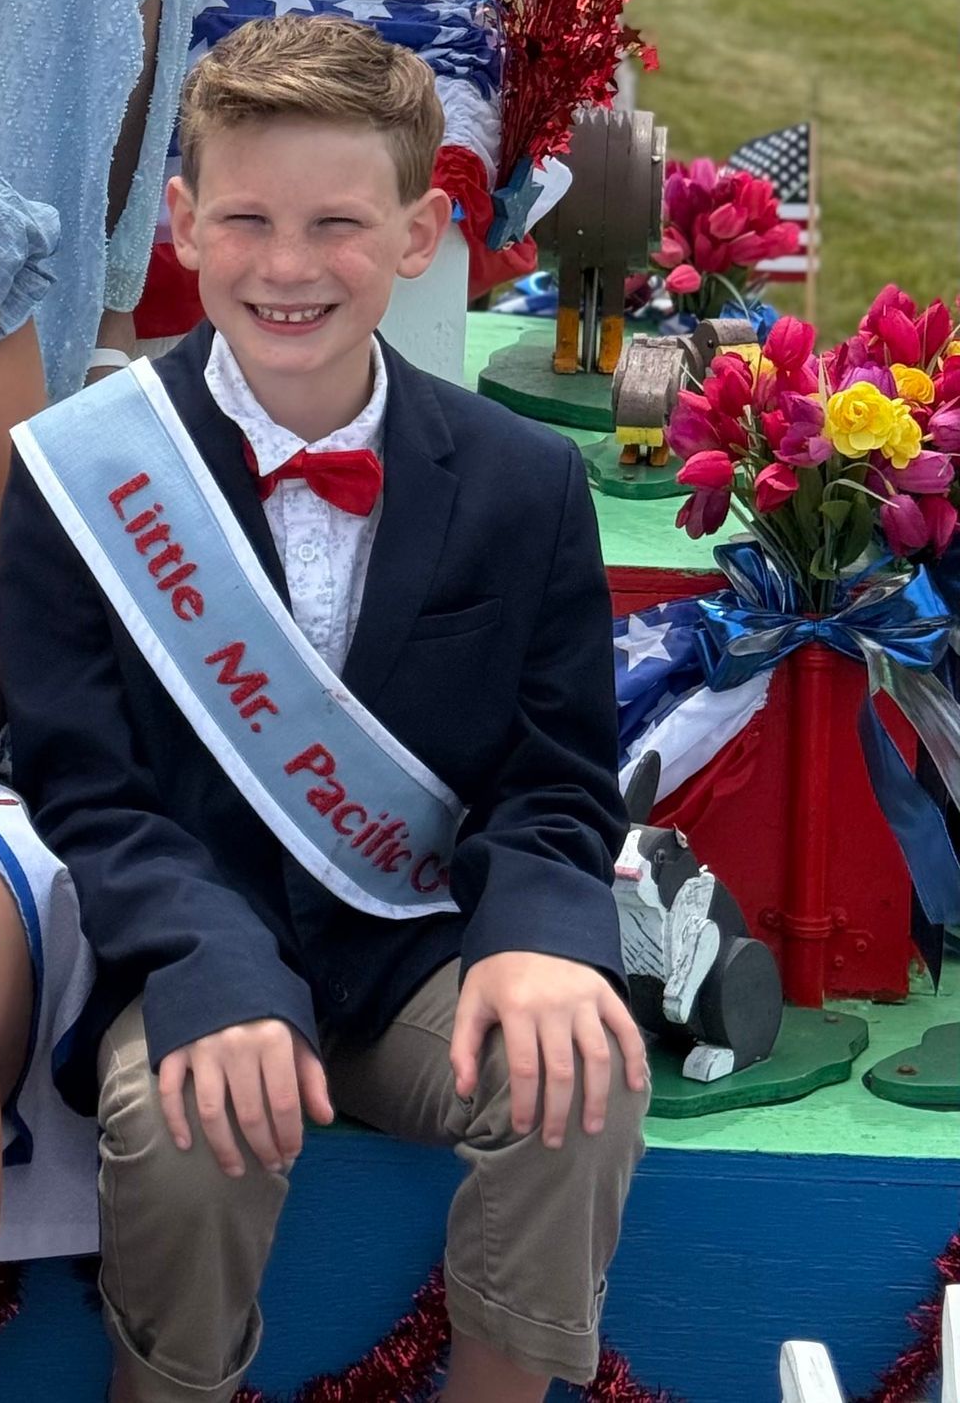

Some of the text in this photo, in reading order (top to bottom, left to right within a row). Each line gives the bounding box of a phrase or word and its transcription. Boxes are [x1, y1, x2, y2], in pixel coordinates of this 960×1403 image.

[107, 471, 205, 622] Little
[204, 640, 279, 734] Mr.
[283, 742, 413, 874] Pacific
